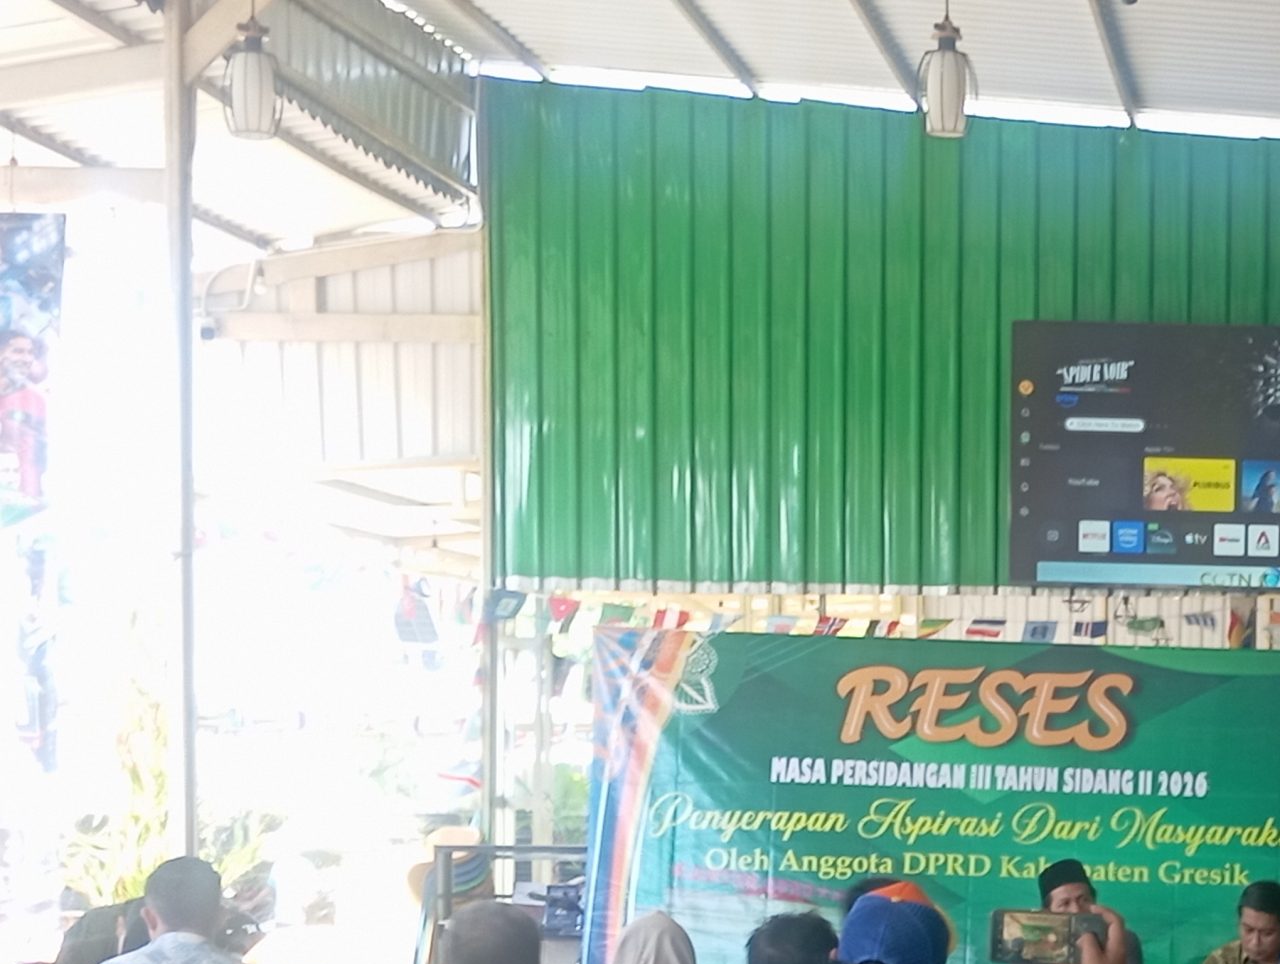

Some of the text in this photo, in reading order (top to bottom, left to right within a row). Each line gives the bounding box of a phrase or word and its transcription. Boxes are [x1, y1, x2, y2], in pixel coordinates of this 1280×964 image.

[836, 664, 1134, 751] RESES
[771, 757, 826, 784] MASA
[830, 759, 965, 788] PERSIDANGAN
[995, 765, 1059, 792] TAHUN
[1062, 767, 1133, 795] SIDANG
[1138, 770, 1152, 795] II
[1157, 771, 1209, 798] 2026
[650, 791, 848, 842] Penyerapan
[857, 798, 1003, 845] Aspirasi
[1011, 802, 1101, 845] Dari
[705, 848, 768, 872] Oleh
[779, 850, 893, 880] Anggota
[903, 853, 991, 878] DPRD
[1158, 860, 1250, 886] Gresik
